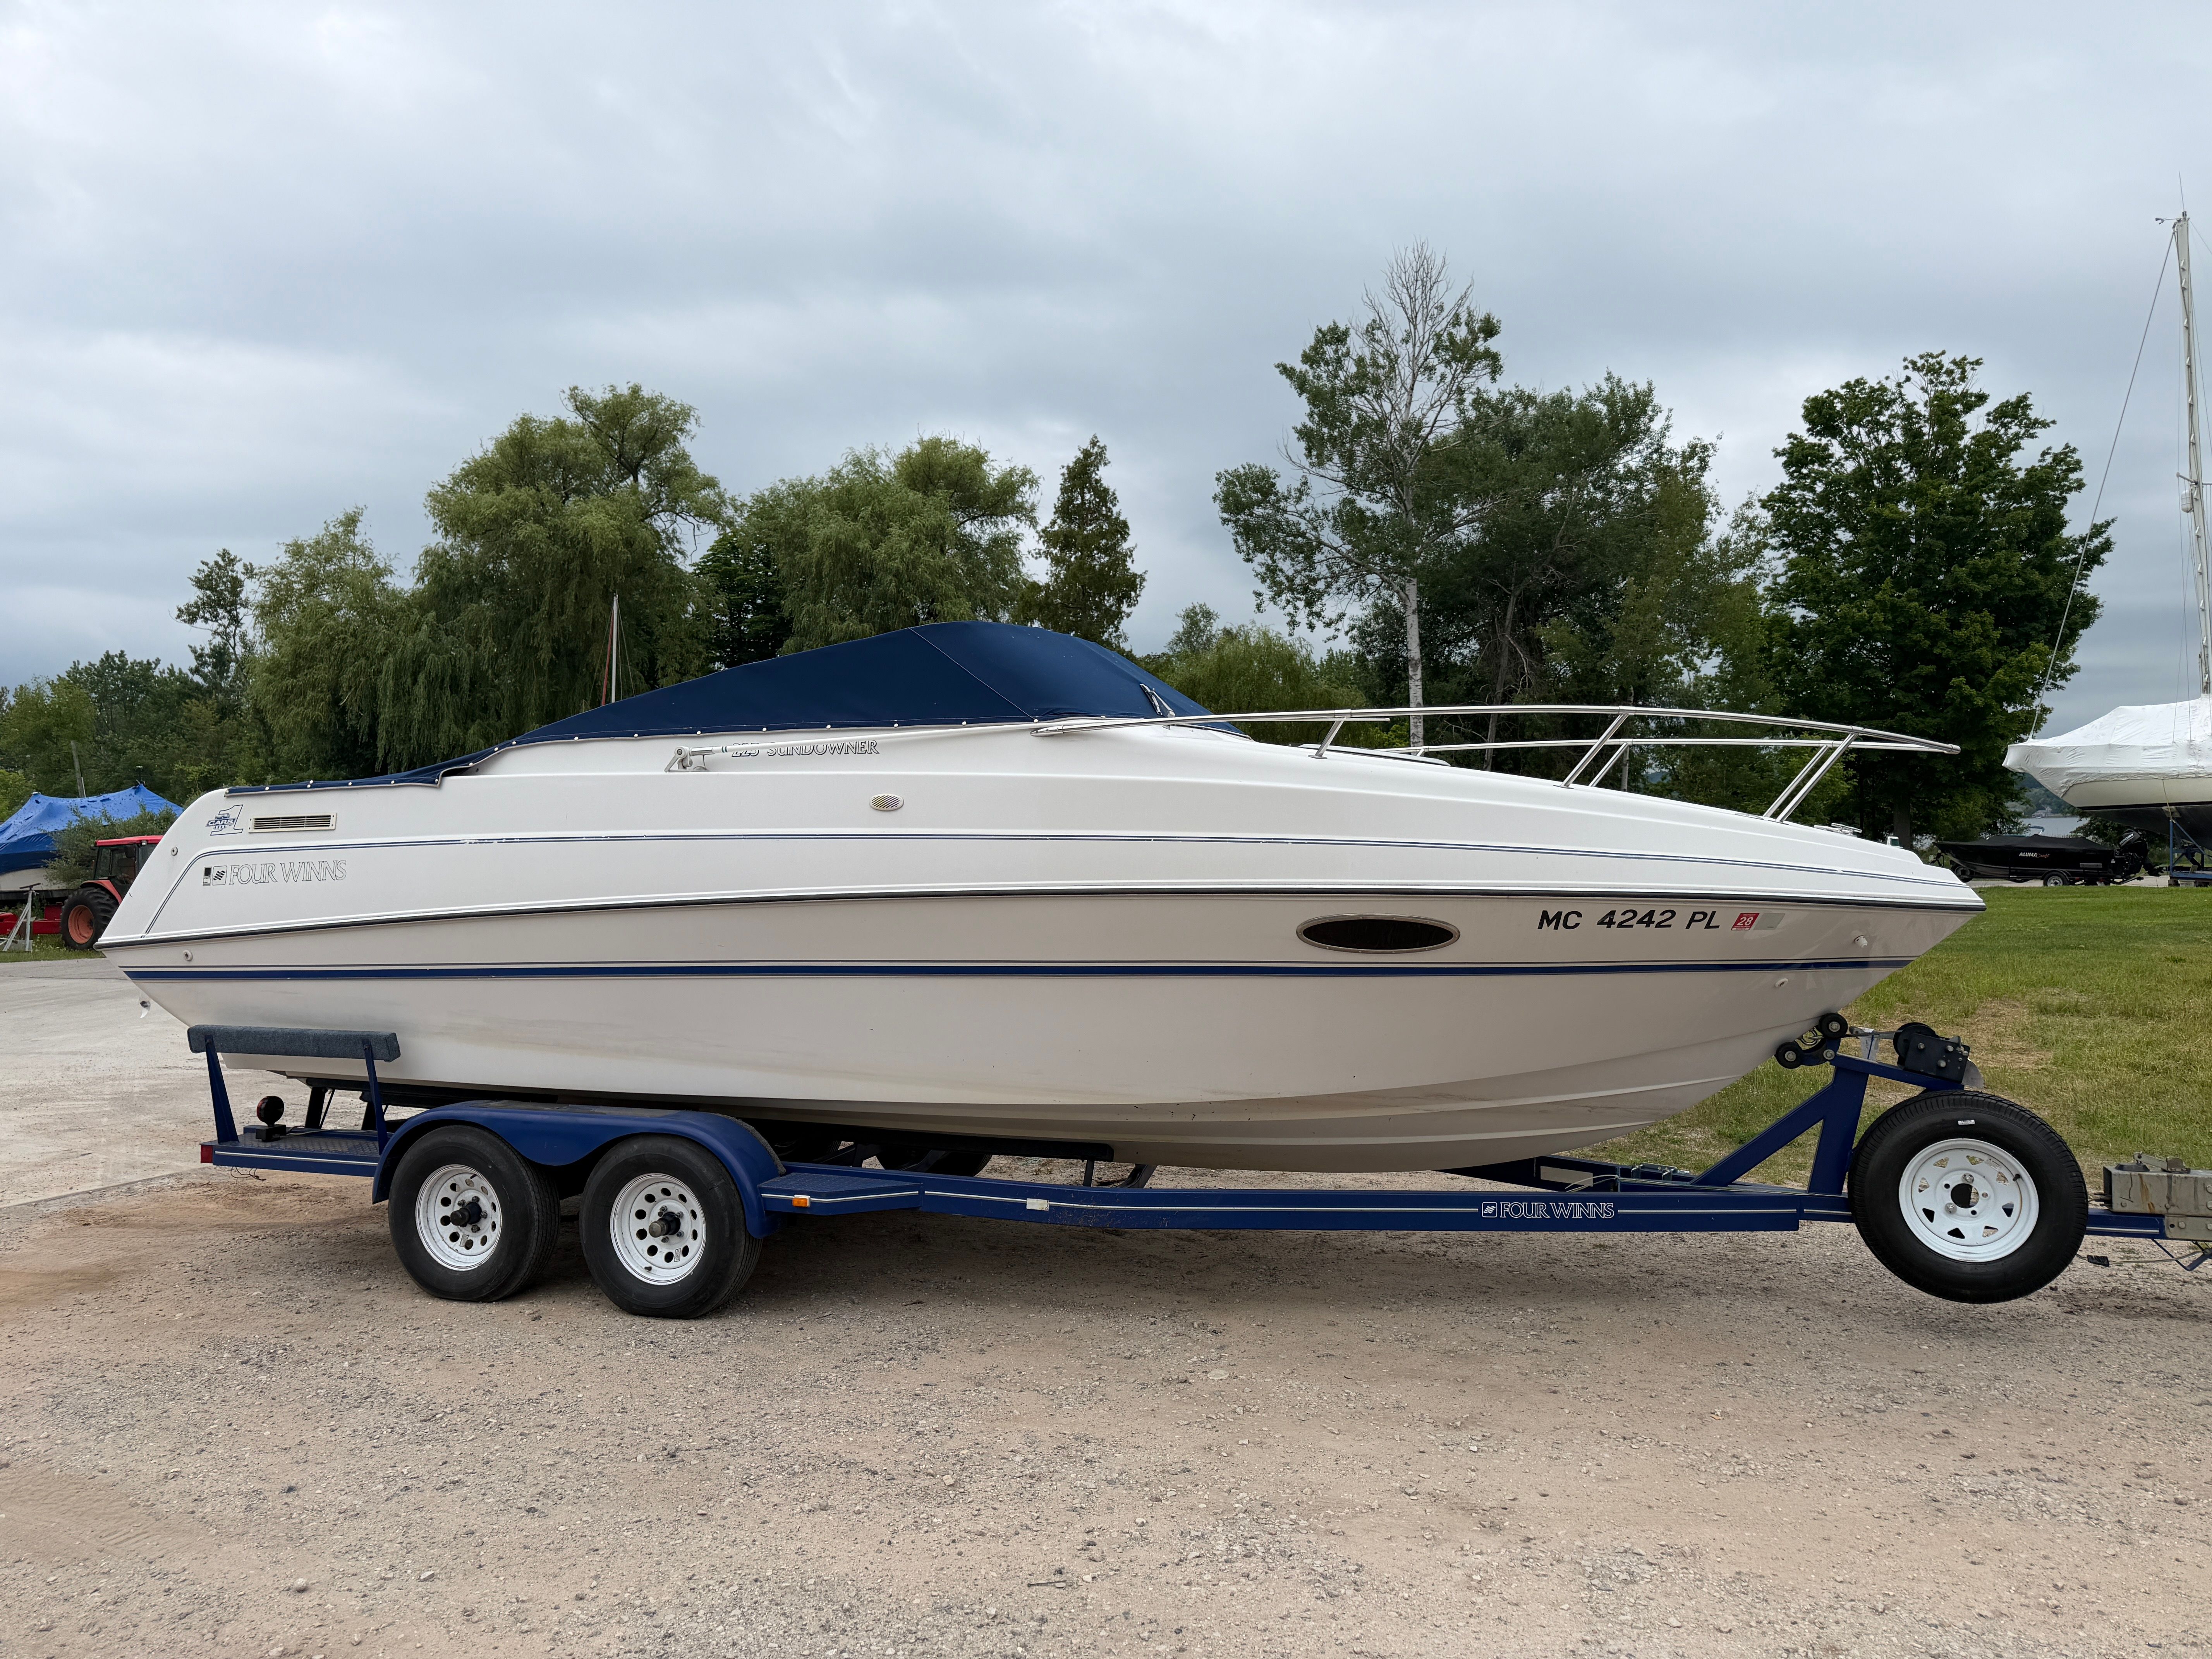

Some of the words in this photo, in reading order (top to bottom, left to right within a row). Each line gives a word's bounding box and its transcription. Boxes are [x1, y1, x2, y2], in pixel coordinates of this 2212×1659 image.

[229, 863, 278, 885] FOUR
[280, 860, 347, 883] WINNS
[1537, 910, 1583, 930] MC
[1596, 909, 1676, 929] 4242
[1685, 910, 1720, 929] PL
[1736, 917, 1753, 926] 28
[1499, 1202, 1551, 1218] FOUR
[1549, 1202, 1615, 1219] WINNS
